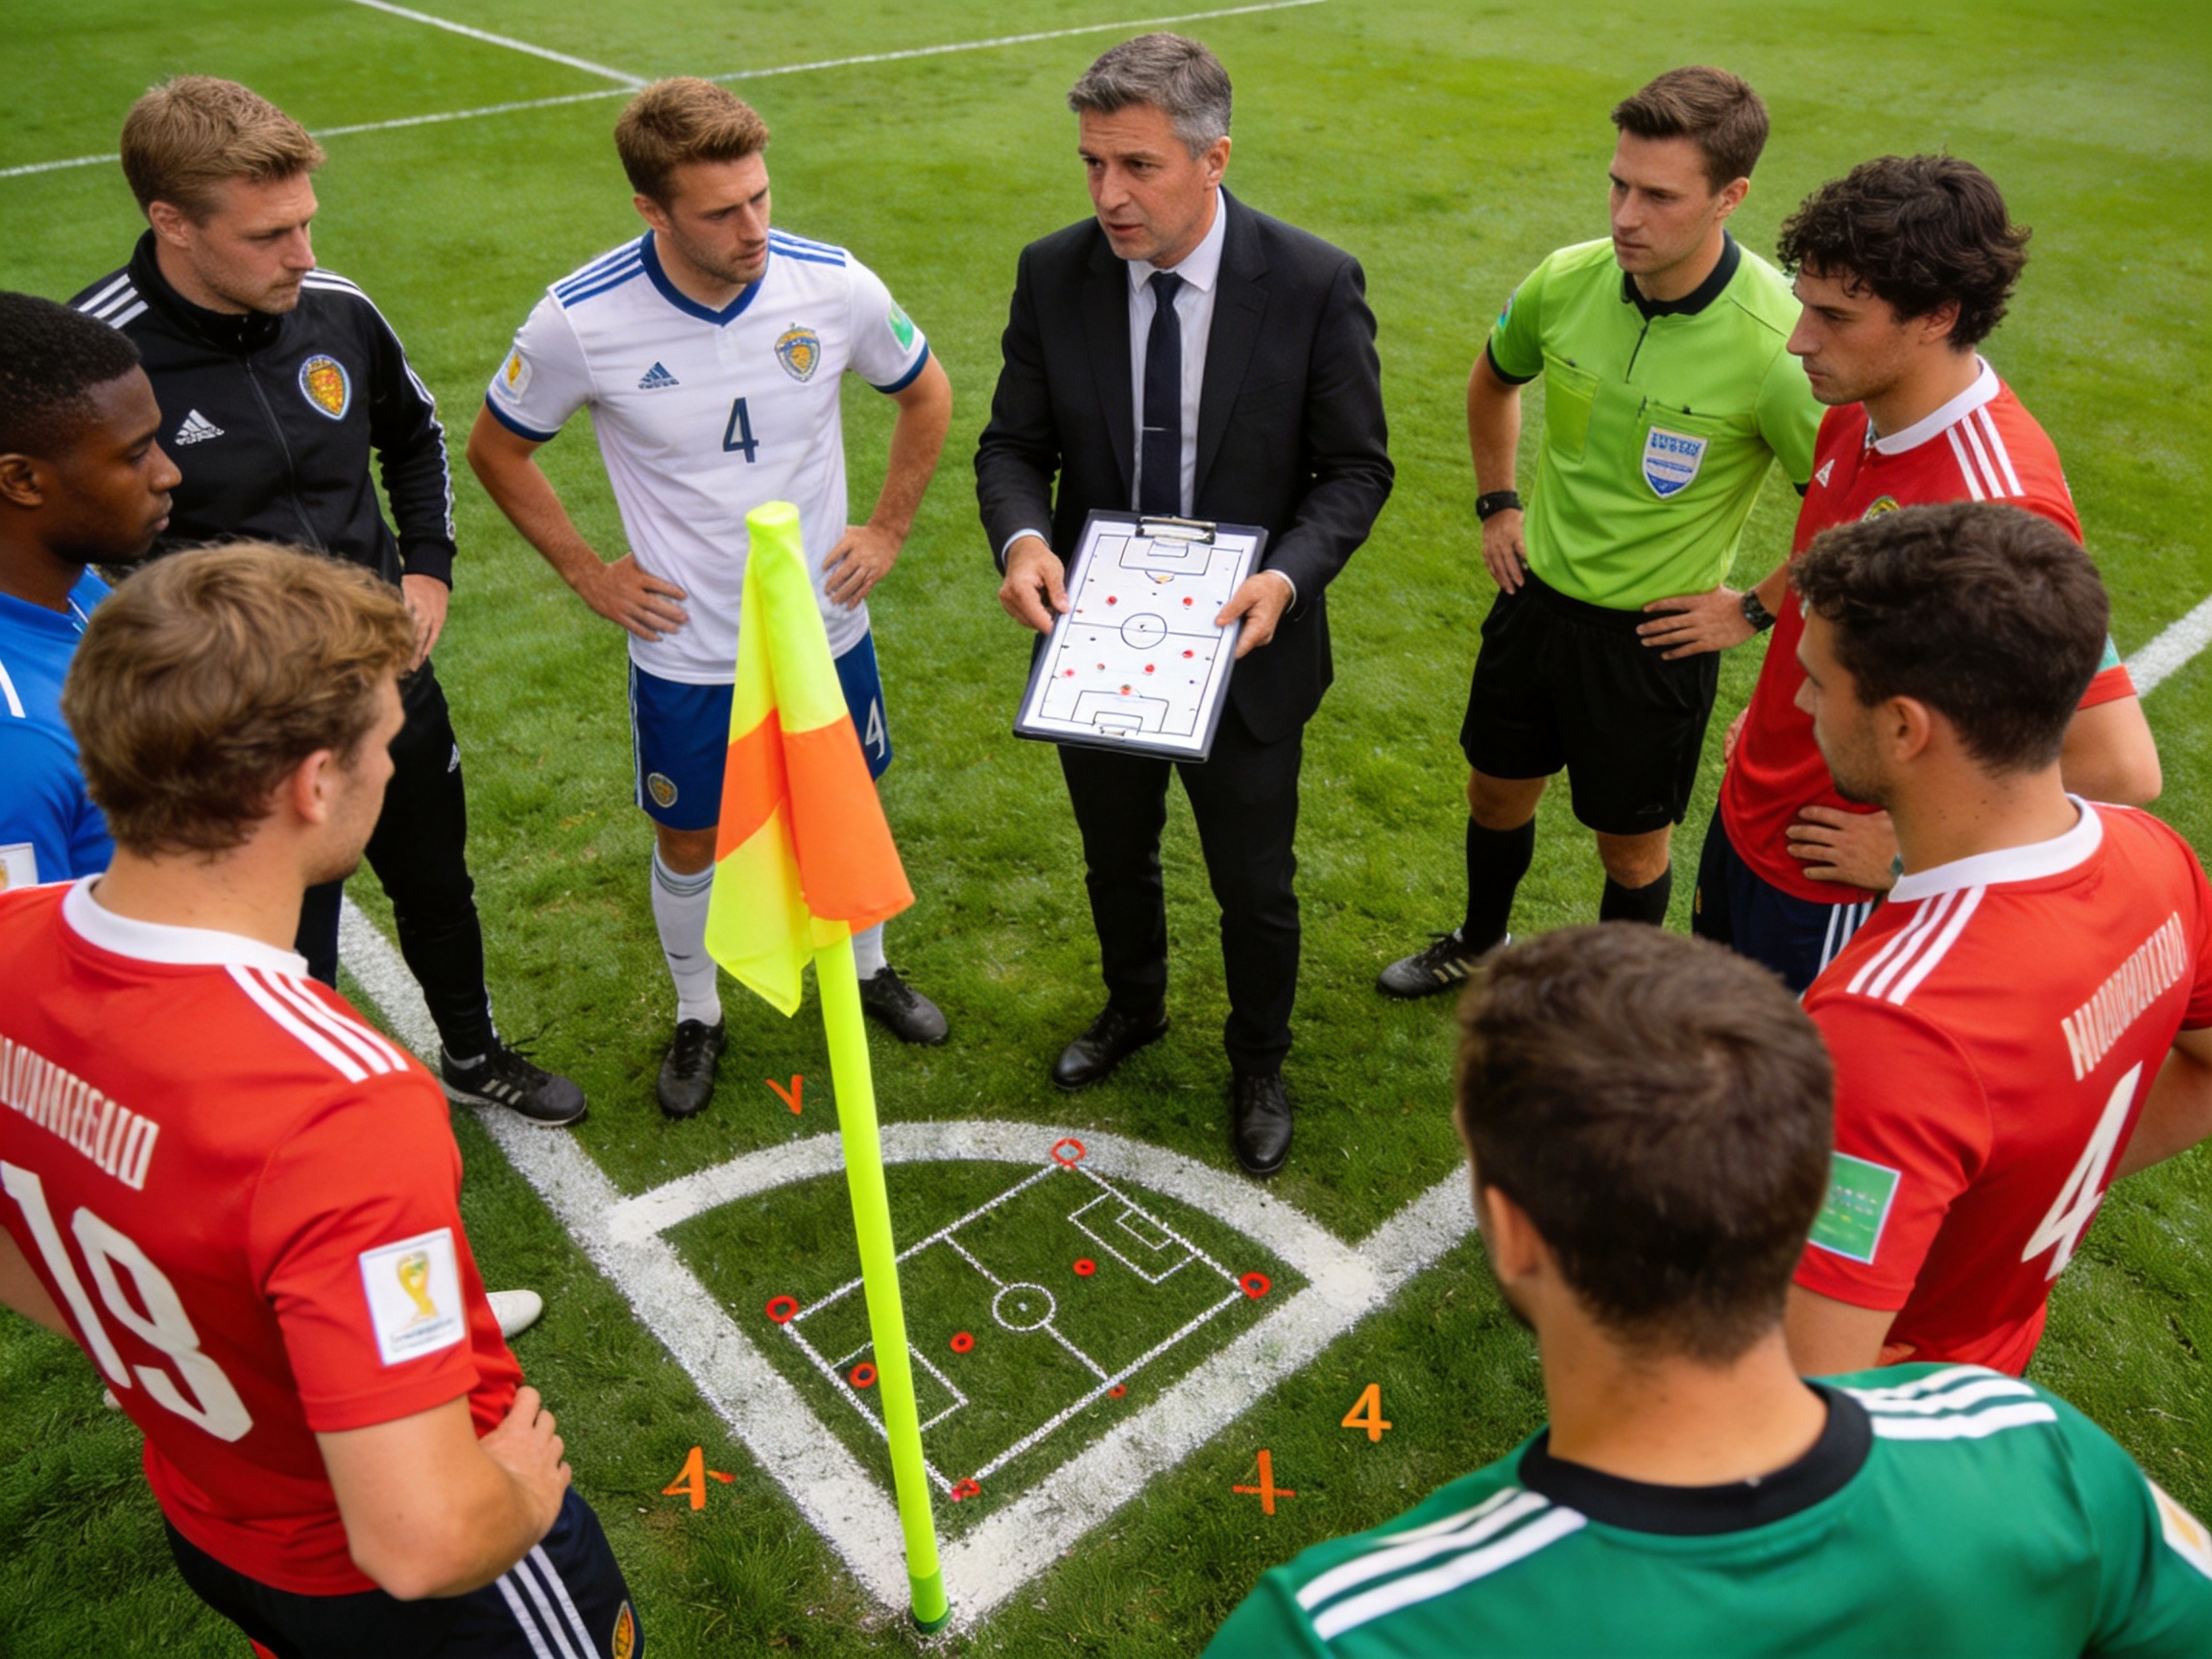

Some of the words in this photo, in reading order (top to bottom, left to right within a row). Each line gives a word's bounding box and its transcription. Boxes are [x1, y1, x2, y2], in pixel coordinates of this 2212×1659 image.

[723, 397, 758, 464] 4
[865, 697, 885, 760] 4
[2021, 1060, 2143, 1282] 4
[1341, 1382, 1392, 1443] 4
